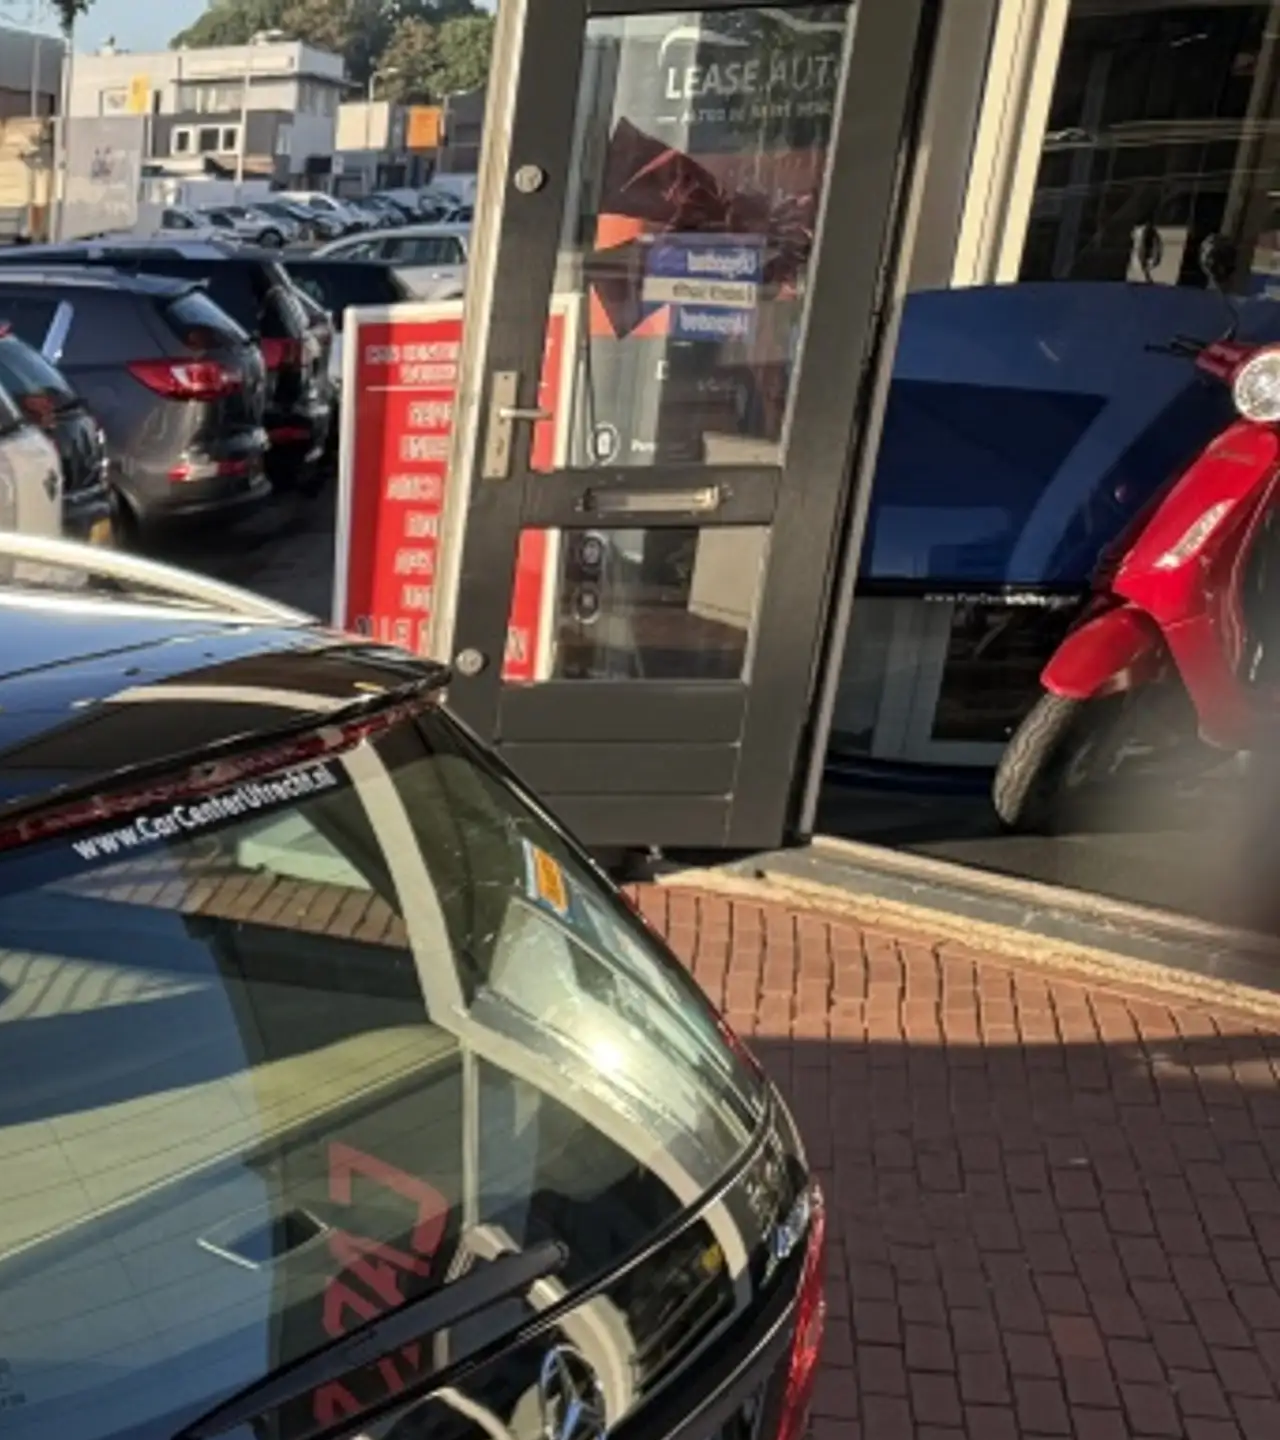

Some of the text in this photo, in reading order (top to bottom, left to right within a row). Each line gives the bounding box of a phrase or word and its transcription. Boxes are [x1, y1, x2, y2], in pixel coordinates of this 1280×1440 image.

[665, 52, 839, 99] LEASE AUT
[72, 762, 338, 860] www.CarCenterUtrecht.nl
